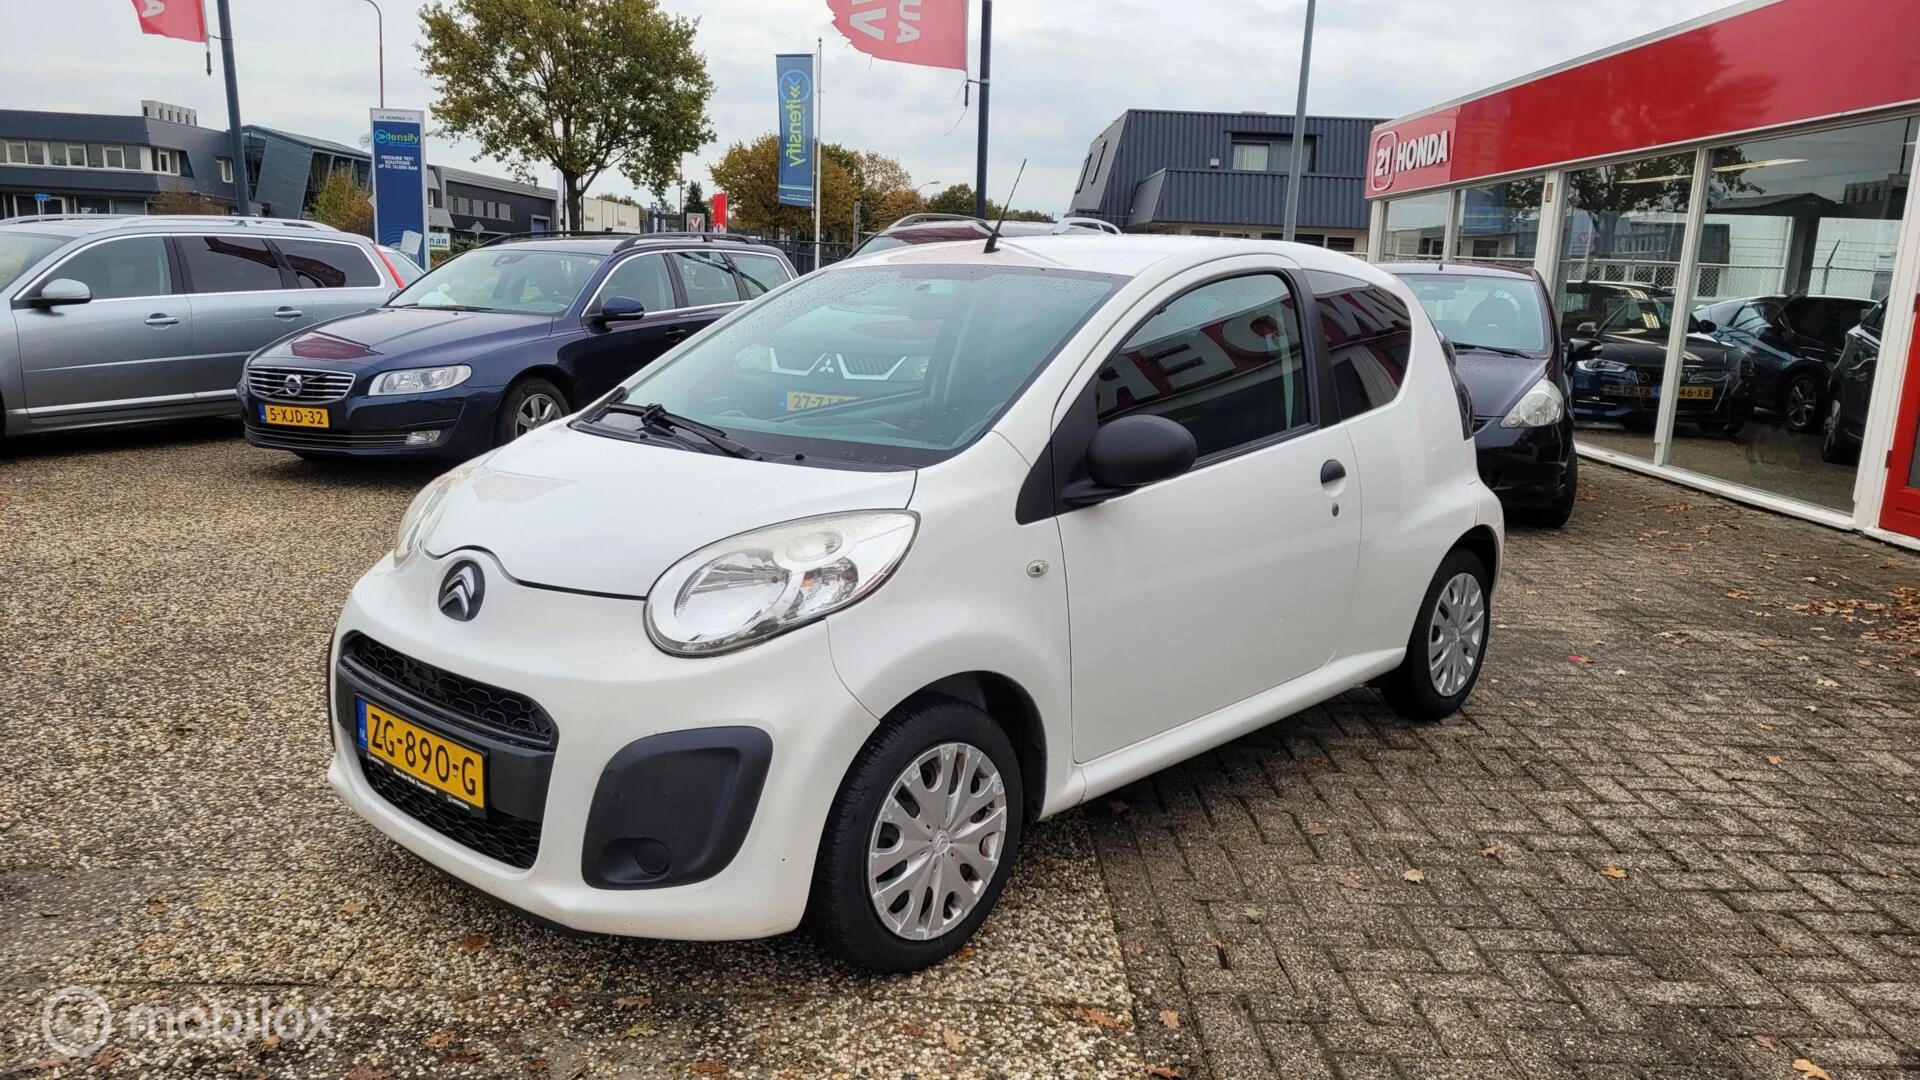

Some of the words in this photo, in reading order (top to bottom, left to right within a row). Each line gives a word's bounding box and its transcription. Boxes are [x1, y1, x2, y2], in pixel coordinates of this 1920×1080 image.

[1396, 130, 1448, 172] HONDA
[270, 408, 324, 425] 5-XJD-32
[371, 712, 476, 796] ZG-890-G
